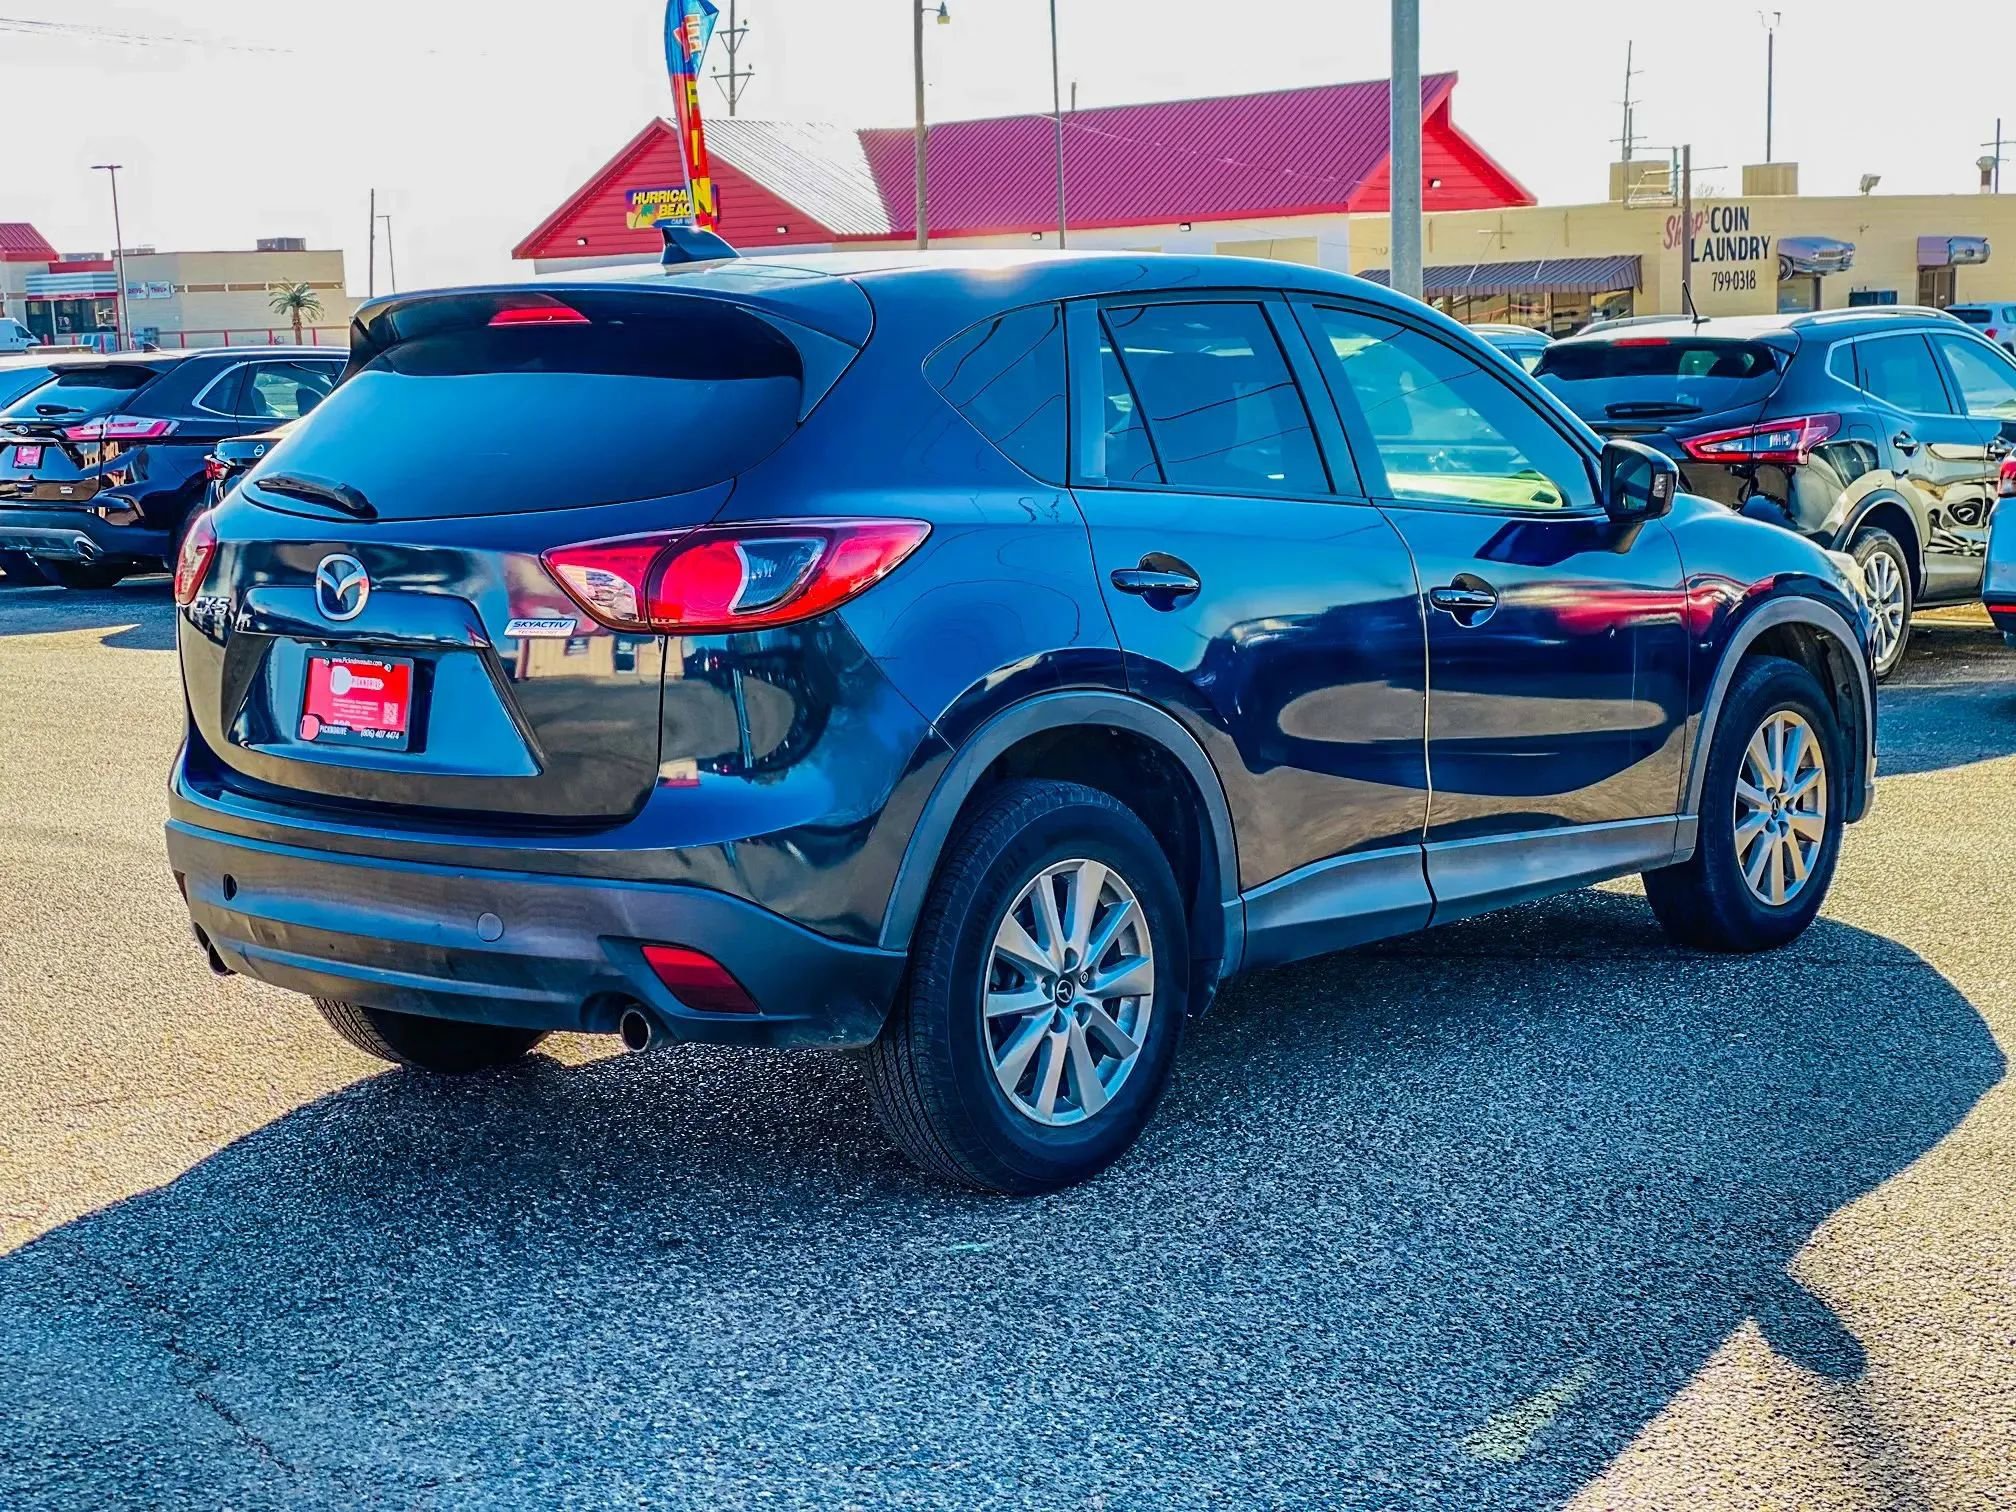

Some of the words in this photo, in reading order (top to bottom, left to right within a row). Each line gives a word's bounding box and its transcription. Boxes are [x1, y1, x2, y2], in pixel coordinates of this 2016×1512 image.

[632, 190, 689, 204] HURRICA
[659, 203, 692, 216] BEAC
[1711, 206, 1749, 233] COIN
[1691, 235, 1771, 263] LAUNDRY
